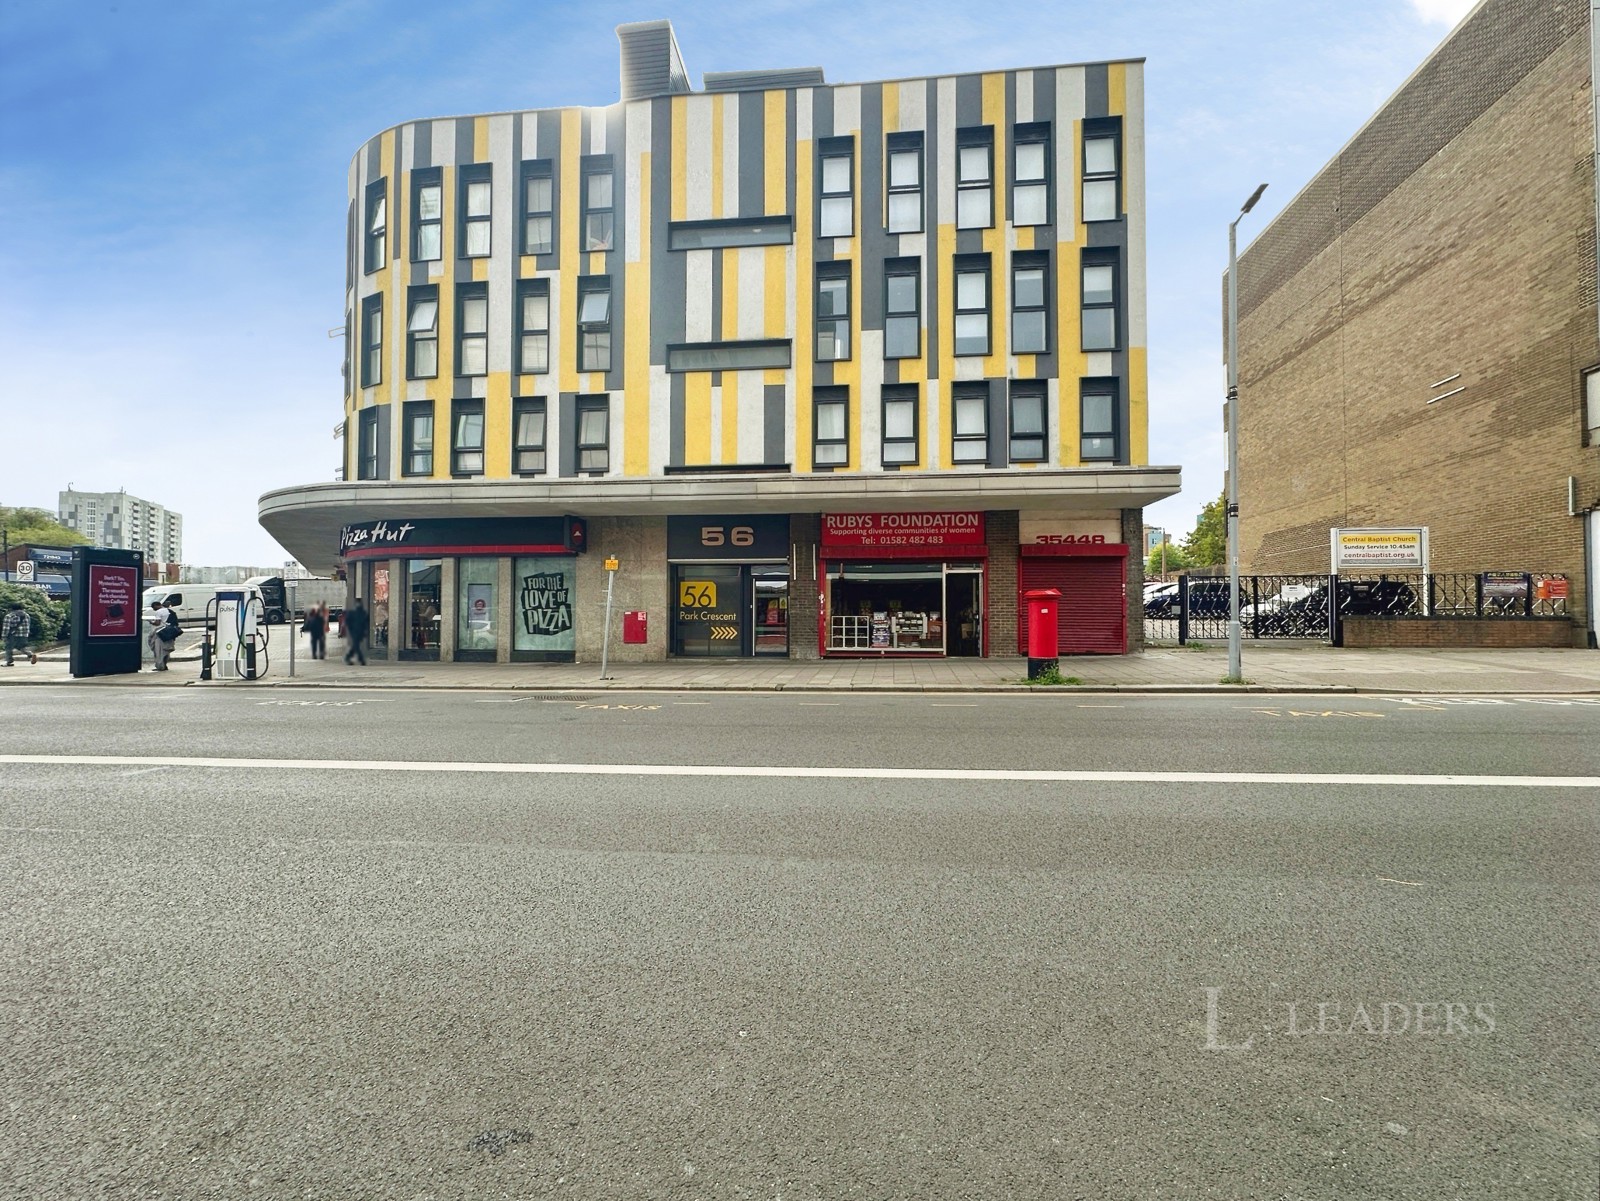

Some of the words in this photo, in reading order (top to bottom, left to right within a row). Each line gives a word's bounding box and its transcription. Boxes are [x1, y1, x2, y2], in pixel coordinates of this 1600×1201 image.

[827, 515, 873, 528] RUBYS
[880, 514, 979, 527] FOUNDATION
[340, 526, 368, 550] Pizza
[371, 521, 415, 543] Hut
[701, 526, 755, 546] 56
[830, 528, 867, 536] Supporting
[894, 527, 939, 535] communities
[861, 536, 876, 544] Tel:
[880, 536, 907, 544] 01582
[909, 536, 925, 544] 482
[927, 536, 944, 544] 483
[1036, 535, 1105, 544] 35448
[527, 577, 545, 590] FOR
[545, 575, 562, 591] THE
[524, 589, 557, 610] LOVE
[557, 591, 567, 603] OF
[682, 586, 712, 608] 56
[219, 605, 235, 614] pulse
[680, 611, 699, 620] Park
[700, 611, 737, 621] Crescent
[527, 604, 571, 634] PIZZA
